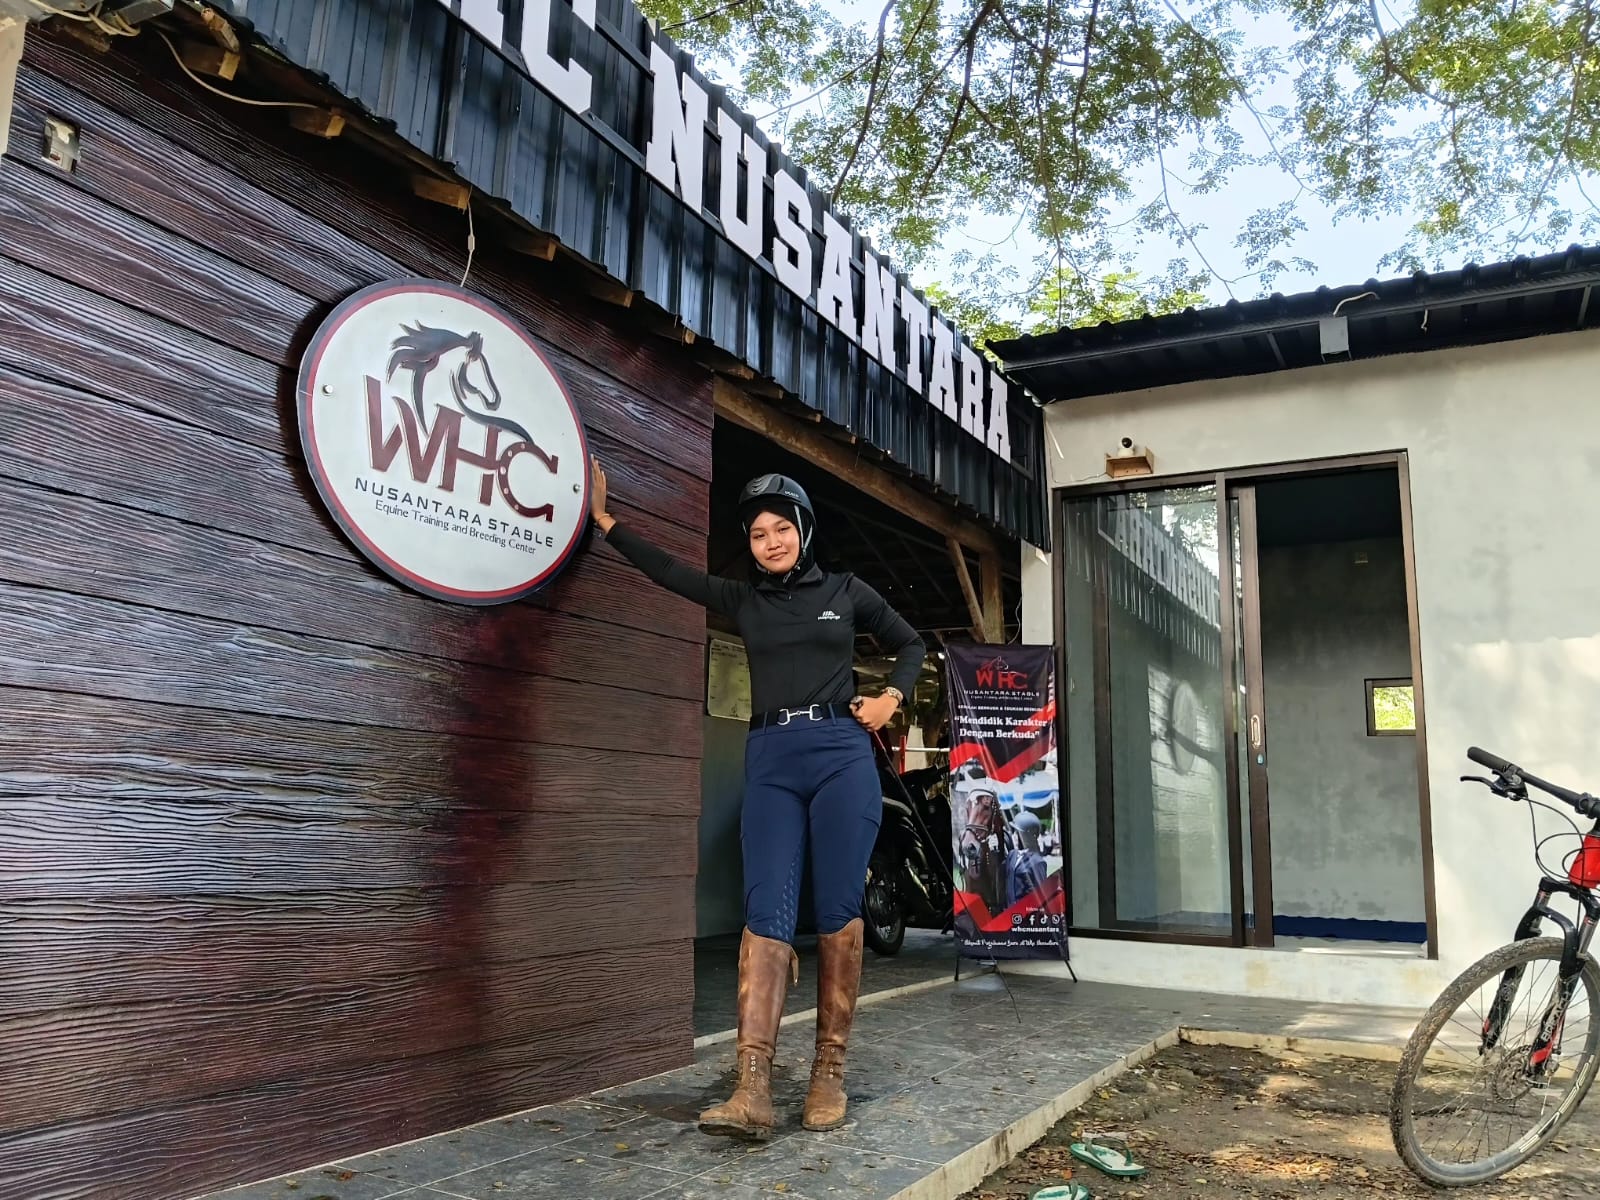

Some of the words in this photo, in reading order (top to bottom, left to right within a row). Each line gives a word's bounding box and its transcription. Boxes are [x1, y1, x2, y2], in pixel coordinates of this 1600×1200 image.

[646, 41, 1011, 462] NUSANTARA
[363, 374, 559, 523] WHC
[354, 477, 482, 526] NUSANTARA
[488, 518, 554, 548] STABLE
[375, 499, 409, 516] Equine
[411, 509, 449, 532] Training
[451, 523, 468, 535] and
[469, 526, 506, 548] Breeding
[508, 538, 536, 555] Center
[976, 669, 1028, 690] WHC
[959, 728, 994, 739] Dengan
[1005, 717, 1048, 727] Karakter
